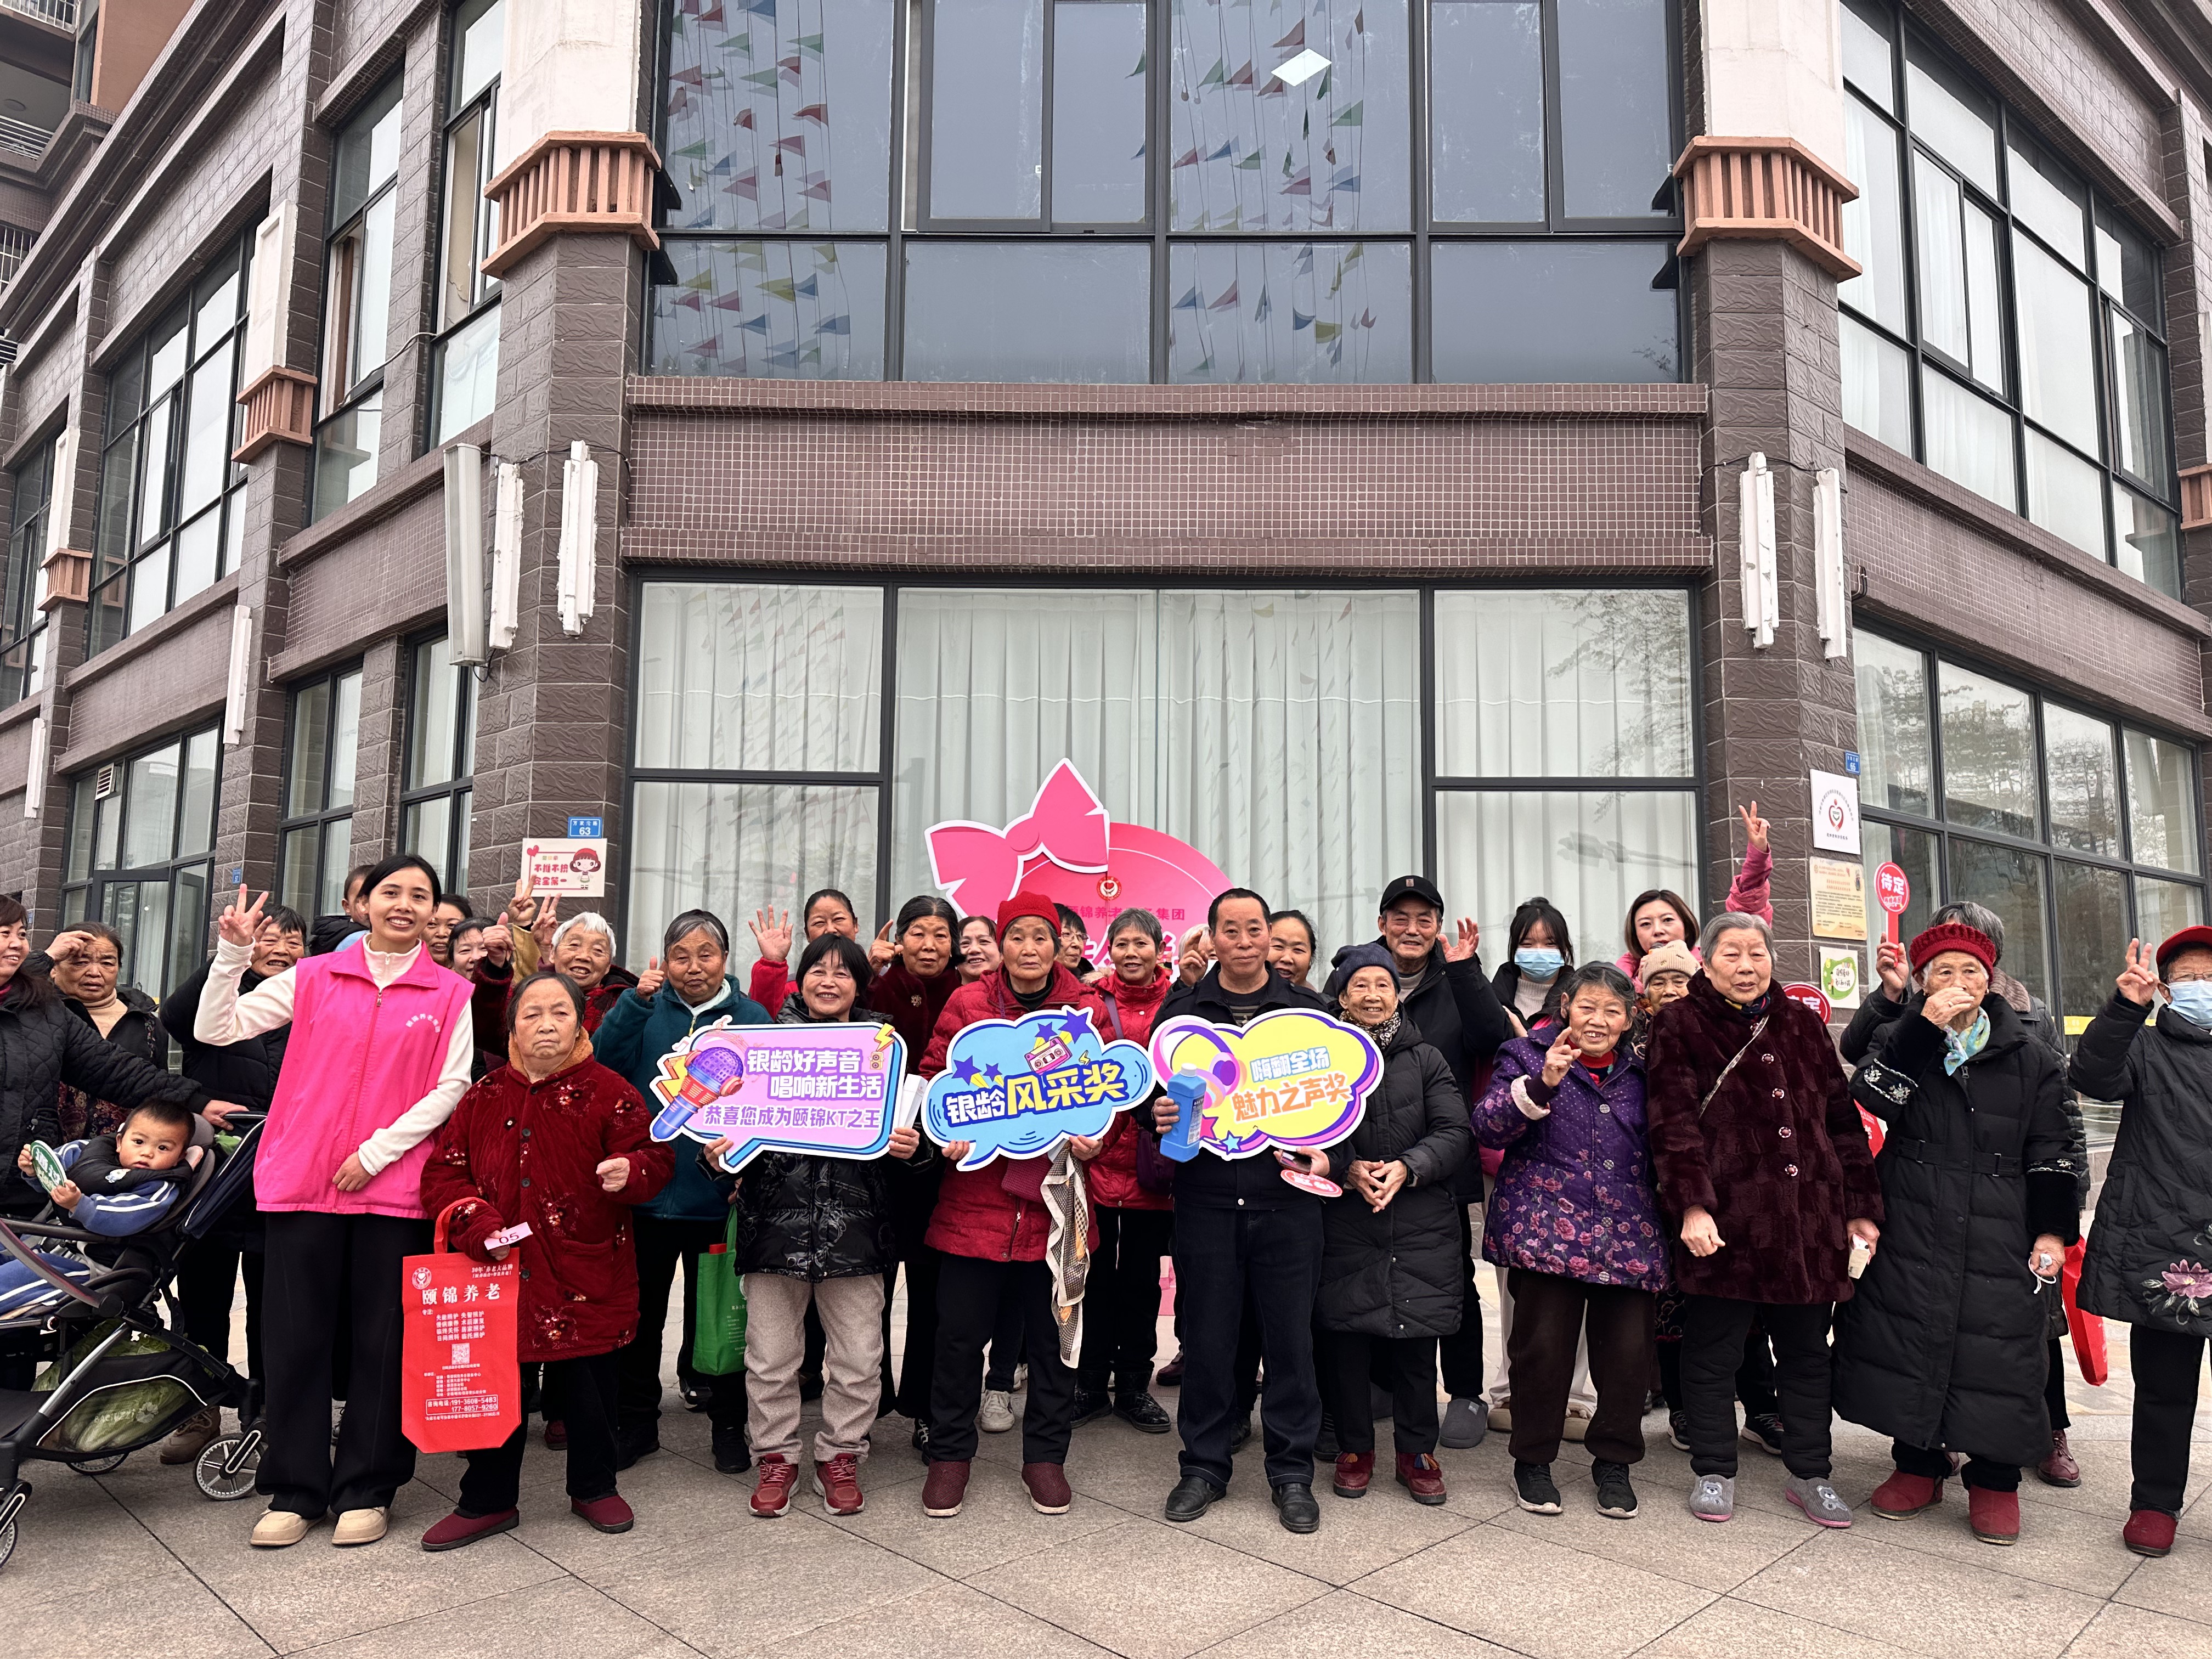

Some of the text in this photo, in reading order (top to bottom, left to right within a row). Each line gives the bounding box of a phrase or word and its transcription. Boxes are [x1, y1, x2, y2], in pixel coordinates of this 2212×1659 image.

[579, 827, 591, 835] 63
[533, 877, 567, 886] 安全第一
[1881, 872, 1905, 896] 待定
[1068, 905, 1185, 921] 锦养老集团
[747, 1049, 861, 1073] 银龄好声音
[1250, 1047, 1330, 1082] 嗨翻全场
[770, 1075, 882, 1098] 唱响新生活
[945, 1063, 1127, 1124] 银龄风采奖
[1232, 1073, 1352, 1121] 魅力之声奖
[705, 1105, 881, 1128] 恭喜您成为颐锦KT之王
[499, 1232, 520, 1244] 05
[422, 1283, 501, 1305] 颐锦养老
